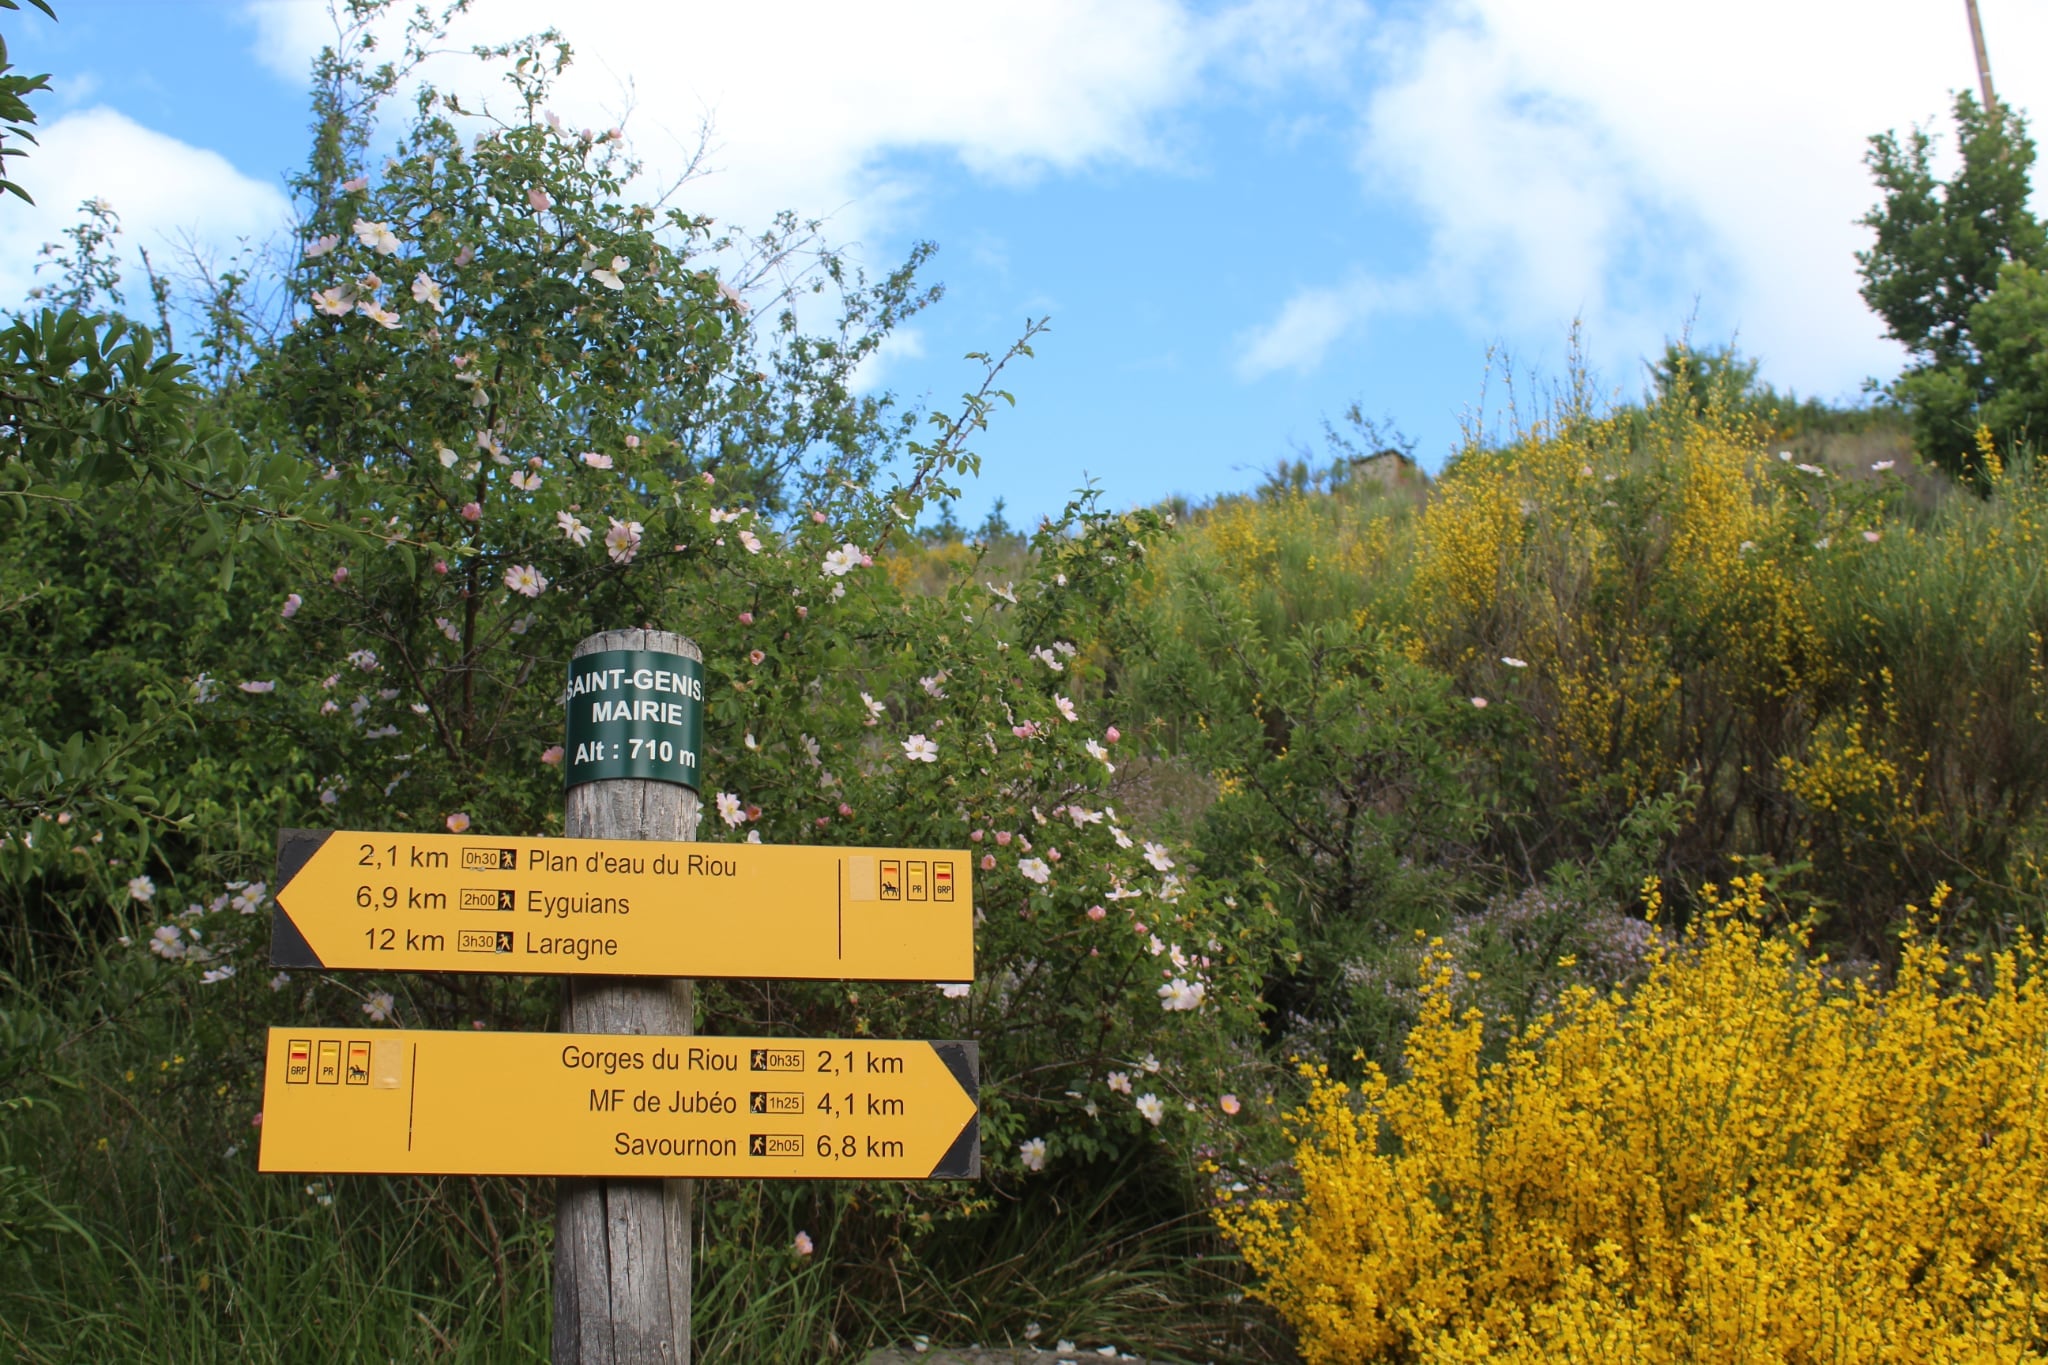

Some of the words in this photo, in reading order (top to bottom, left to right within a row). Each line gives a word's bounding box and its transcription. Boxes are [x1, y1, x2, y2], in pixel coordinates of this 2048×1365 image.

[592, 700, 682, 725] MAIRIE
[574, 741, 604, 765] Alt
[629, 739, 673, 760] 710
[680, 751, 695, 768] m
[358, 844, 396, 870] 2,1
[411, 846, 448, 868] km
[466, 853, 497, 865] 0h30
[530, 850, 577, 872] Plan
[586, 851, 645, 874] d'eau
[653, 854, 678, 875] du
[688, 854, 736, 876] Riou
[357, 886, 398, 912] 6,9
[409, 887, 446, 909] km
[464, 894, 495, 906] 2h00
[528, 891, 629, 918] Eyguians
[366, 928, 395, 950] 12
[407, 929, 444, 951] km
[463, 935, 493, 947] 3h30
[527, 932, 617, 960] Laragne
[562, 1046, 644, 1075] Gorges
[652, 1048, 678, 1070] du
[688, 1048, 737, 1071] Riou
[770, 1055, 800, 1067] 0h35
[818, 1051, 853, 1077] 2,1
[867, 1051, 903, 1074] km
[590, 1089, 625, 1112] MF
[633, 1090, 660, 1112] de
[668, 1090, 736, 1113] Jubéo
[770, 1097, 799, 1109] 1h25
[817, 1093, 853, 1119] 4,1
[868, 1093, 903, 1115] km
[615, 1132, 736, 1157] Savournon
[769, 1139, 799, 1152] 2h05
[817, 1135, 856, 1161] 6,8
[867, 1136, 903, 1157] km
